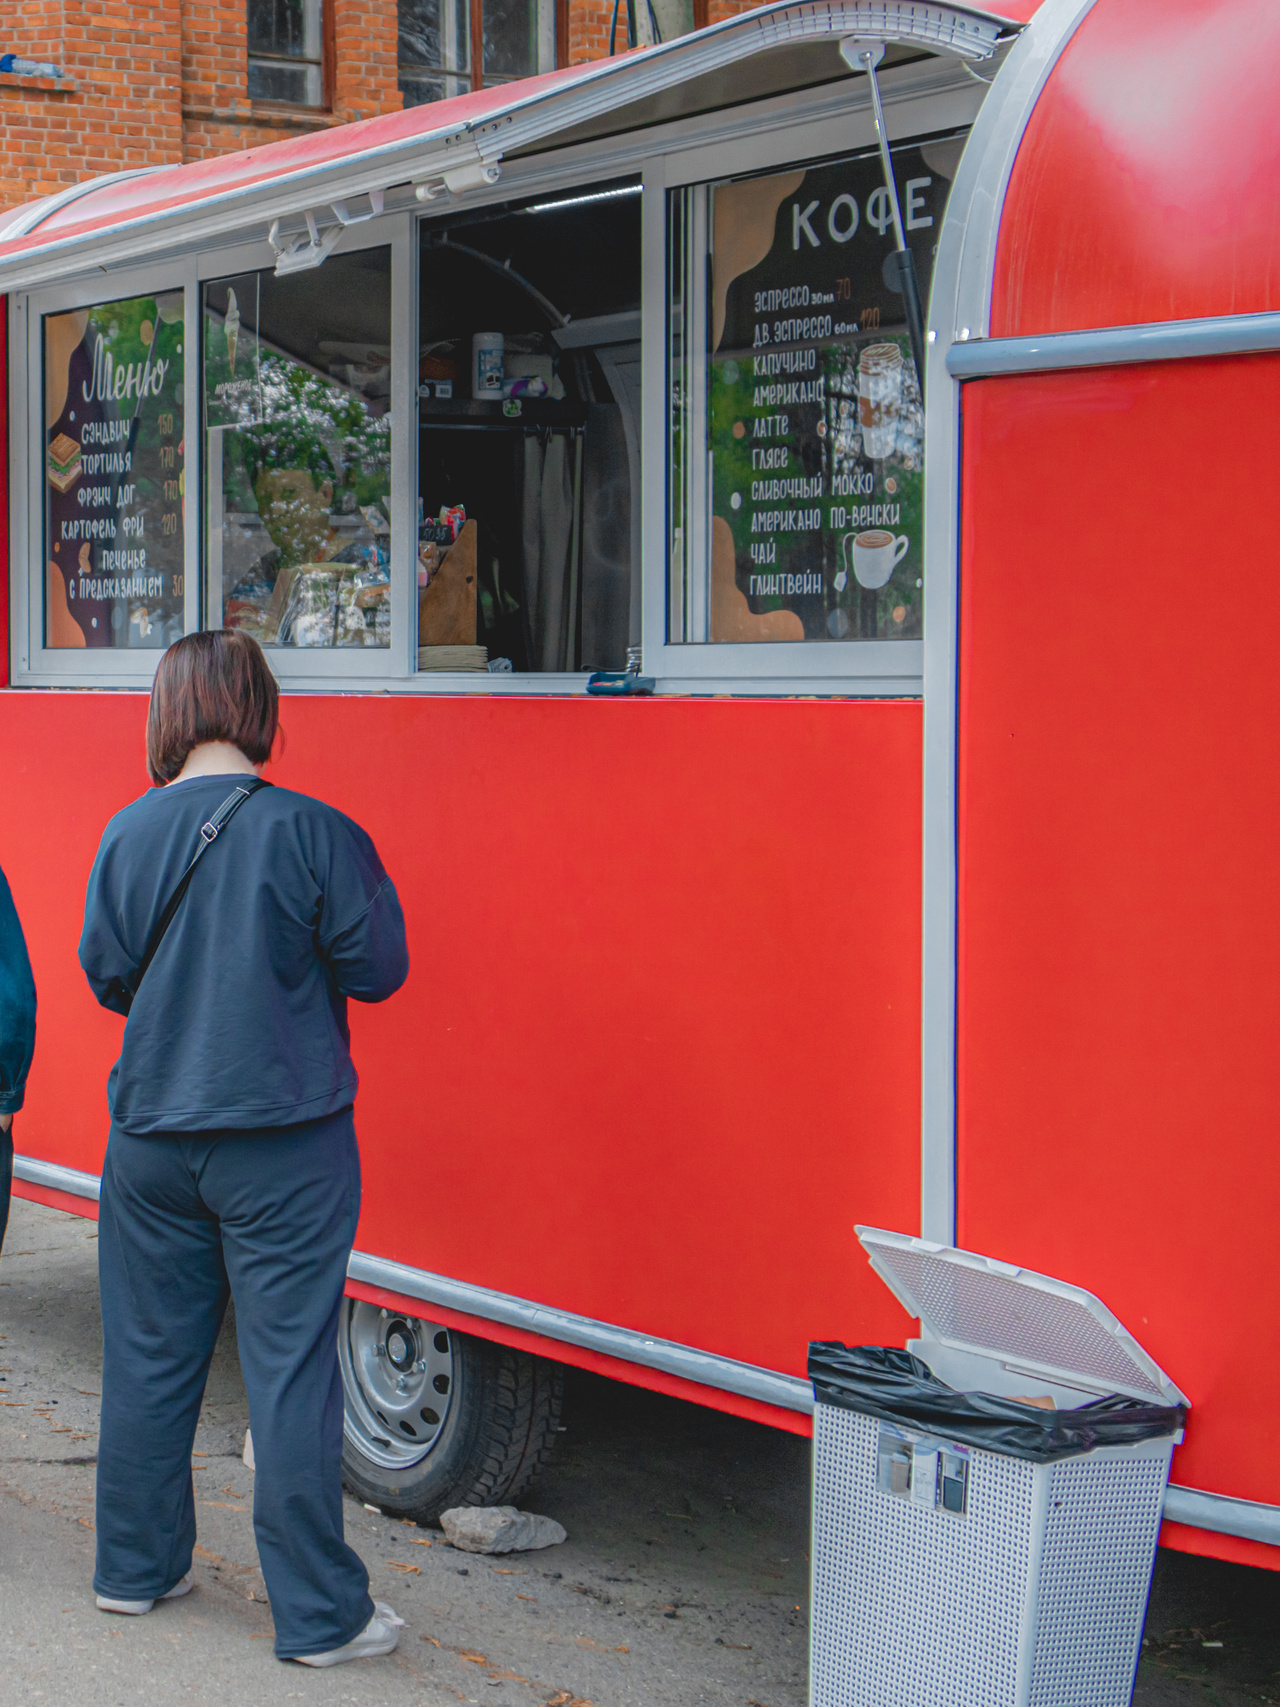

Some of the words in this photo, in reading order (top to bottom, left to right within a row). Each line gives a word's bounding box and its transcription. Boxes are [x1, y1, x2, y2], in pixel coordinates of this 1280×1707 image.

[793, 176, 933, 250] КОФЕ
[755, 285, 809, 313] ЭСПРЕССО
[836, 277, 851, 300] 70
[860, 307, 880, 331] 120
[82, 332, 169, 402] Меню
[753, 349, 816, 376] КАПУЧИНО
[753, 380, 824, 407] АМЕРИКАНО
[81, 419, 130, 445] СЭНДВИЧ
[158, 413, 173, 434] 150
[753, 415, 789, 438] ЛАТТЕ
[81, 451, 131, 475] ТОРТИЛЬЯ
[752, 446, 789, 471] ГЛЯСЕ
[77, 486, 111, 507] ФРЭНЧ
[116, 484, 136, 509] ДОГ
[751, 471, 823, 500] СЛИВОЧНЫЙ
[831, 473, 874, 496] МОККО
[61, 518, 117, 540] КАРТОФЕЛЬ
[122, 516, 144, 537] ФРИ
[750, 508, 821, 533] АМЕРИКАНО
[830, 503, 901, 529] ПО-ВЕНСКИ
[102, 548, 147, 570] ПЕЧЕНЬЕ
[750, 537, 776, 564] ЧАЙ
[69, 578, 76, 599] С
[79, 575, 164, 601] ПРЕДСКАЗАНИЕМ
[750, 569, 822, 595] ГЛИНТВЕЙН
